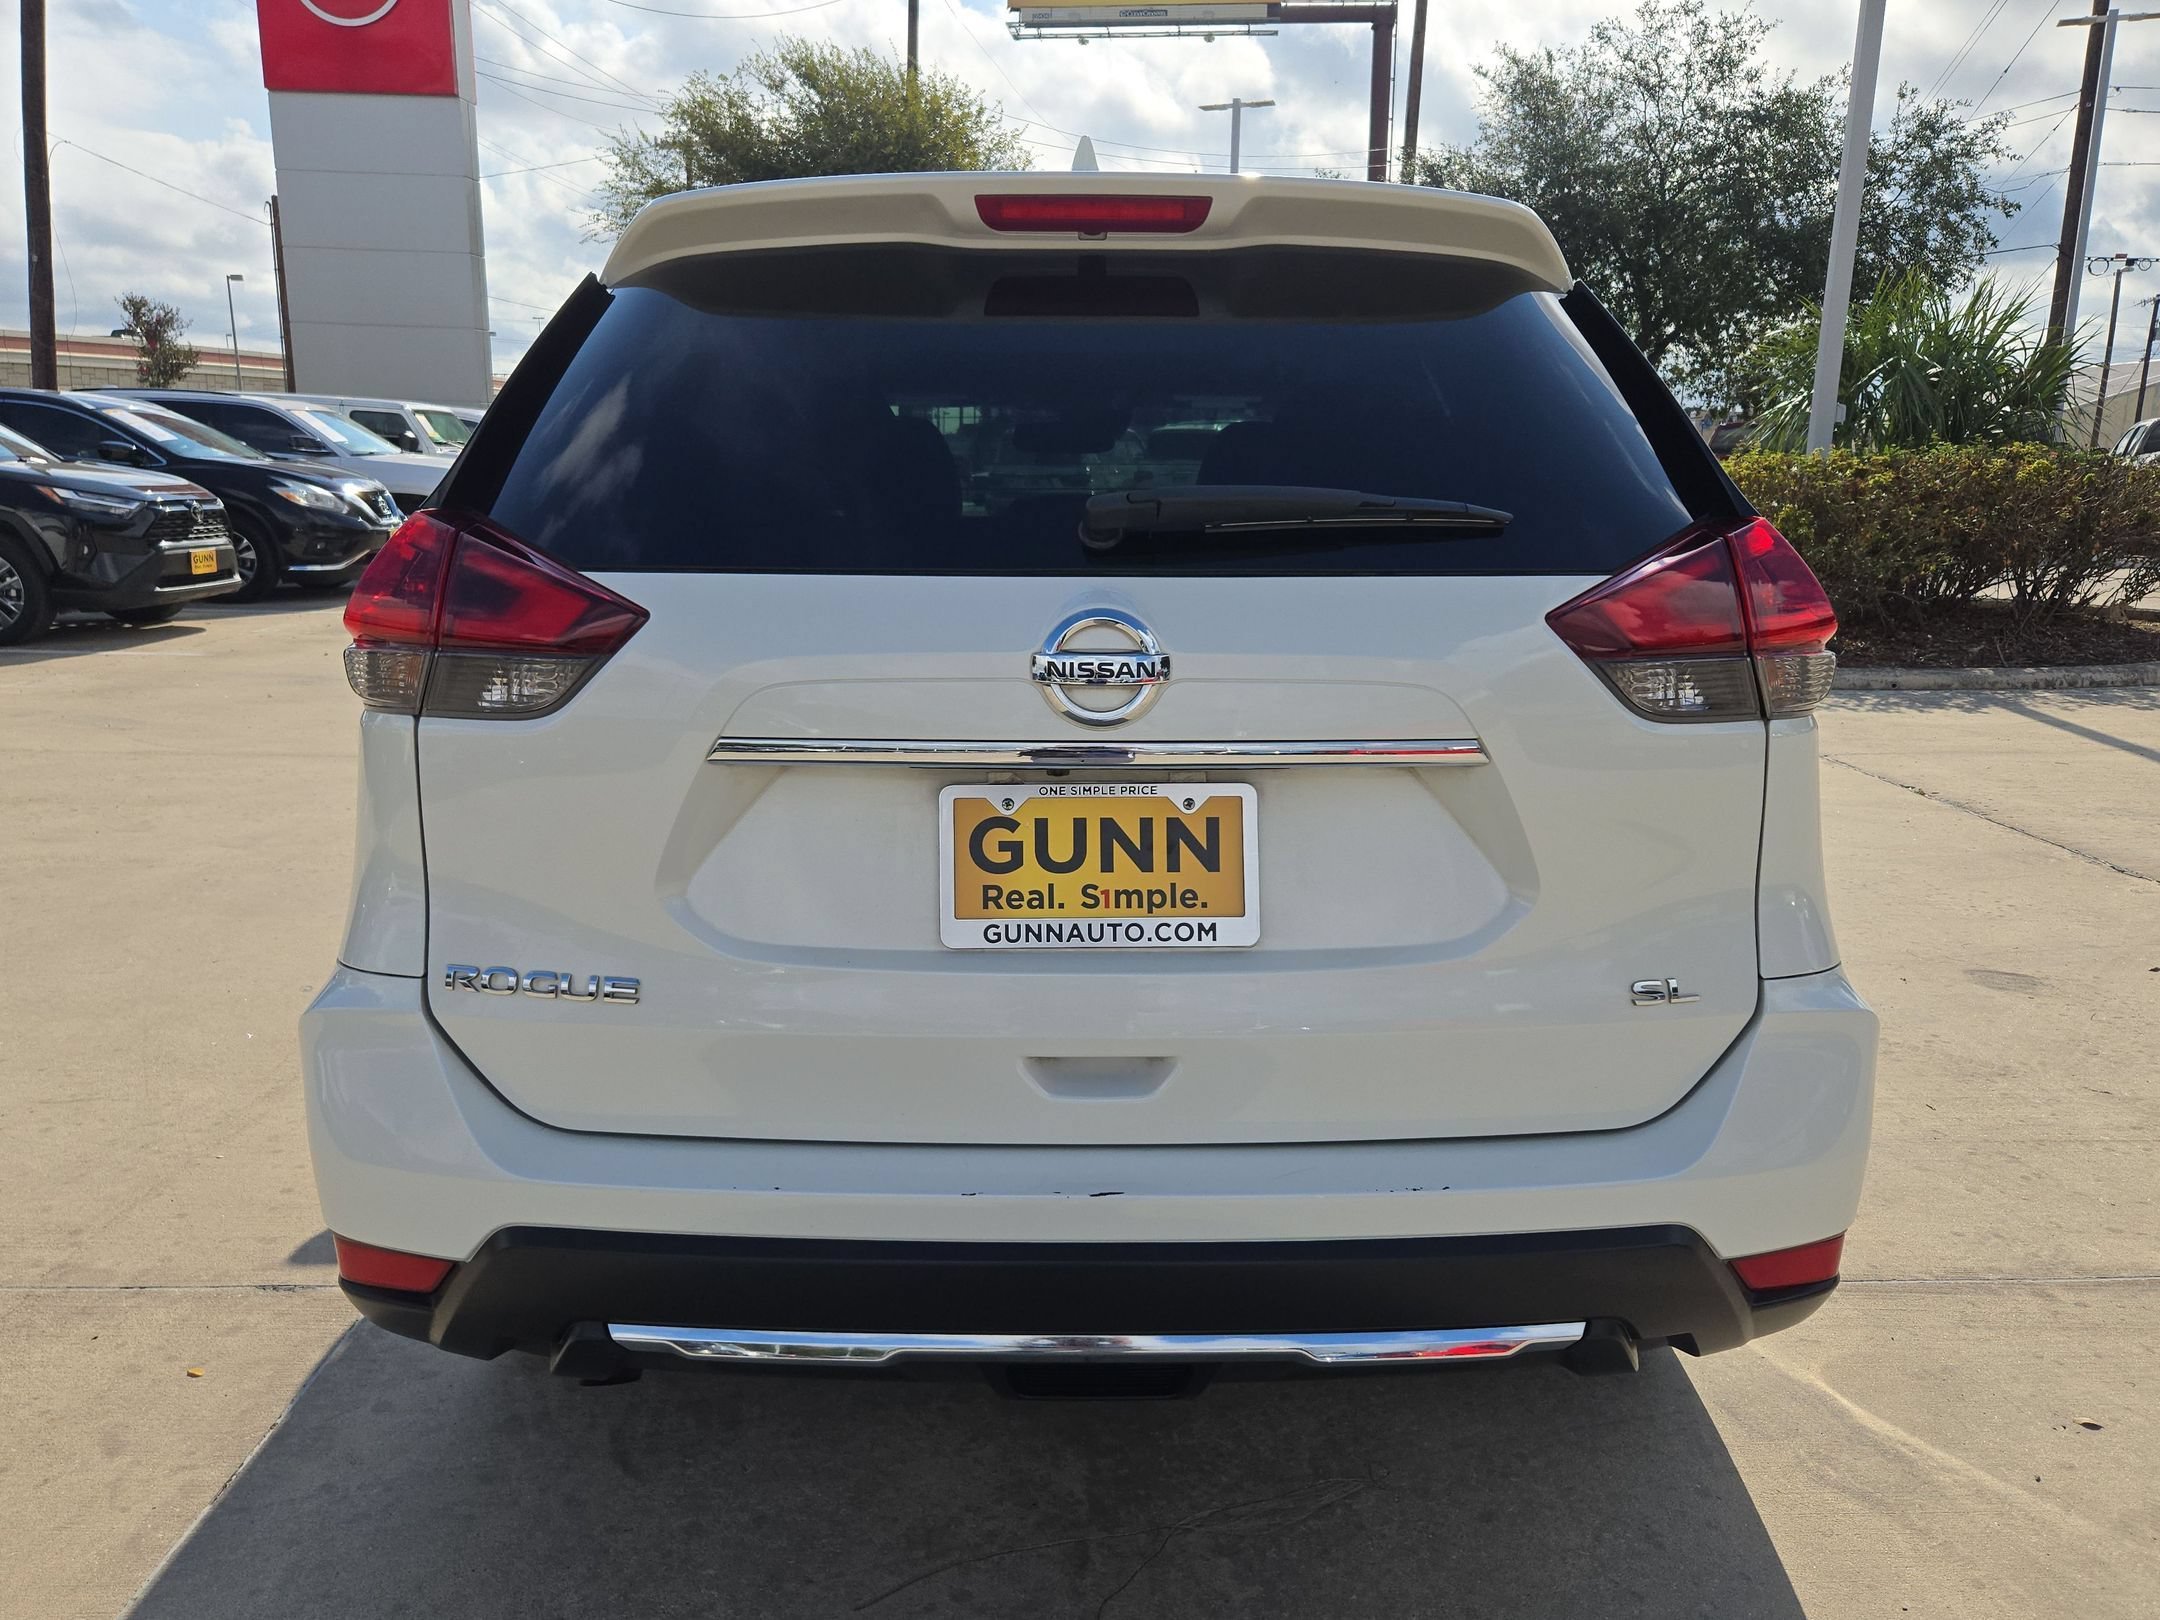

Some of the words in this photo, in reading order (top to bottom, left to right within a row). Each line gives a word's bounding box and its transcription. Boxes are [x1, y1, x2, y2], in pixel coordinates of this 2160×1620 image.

[193, 552, 214, 564] GUNN
[1047, 661, 1156, 679] NISSAN
[1039, 786, 1066, 796] ONE
[1070, 785, 1116, 796] SIMPLE
[1120, 785, 1158, 795] PRICE
[969, 816, 1221, 874] GUNN
[981, 883, 1065, 910] Real.
[983, 922, 1218, 944] GUNNAUTO.COM
[444, 963, 641, 1005] ROGUE
[1630, 977, 1701, 1006] SL
